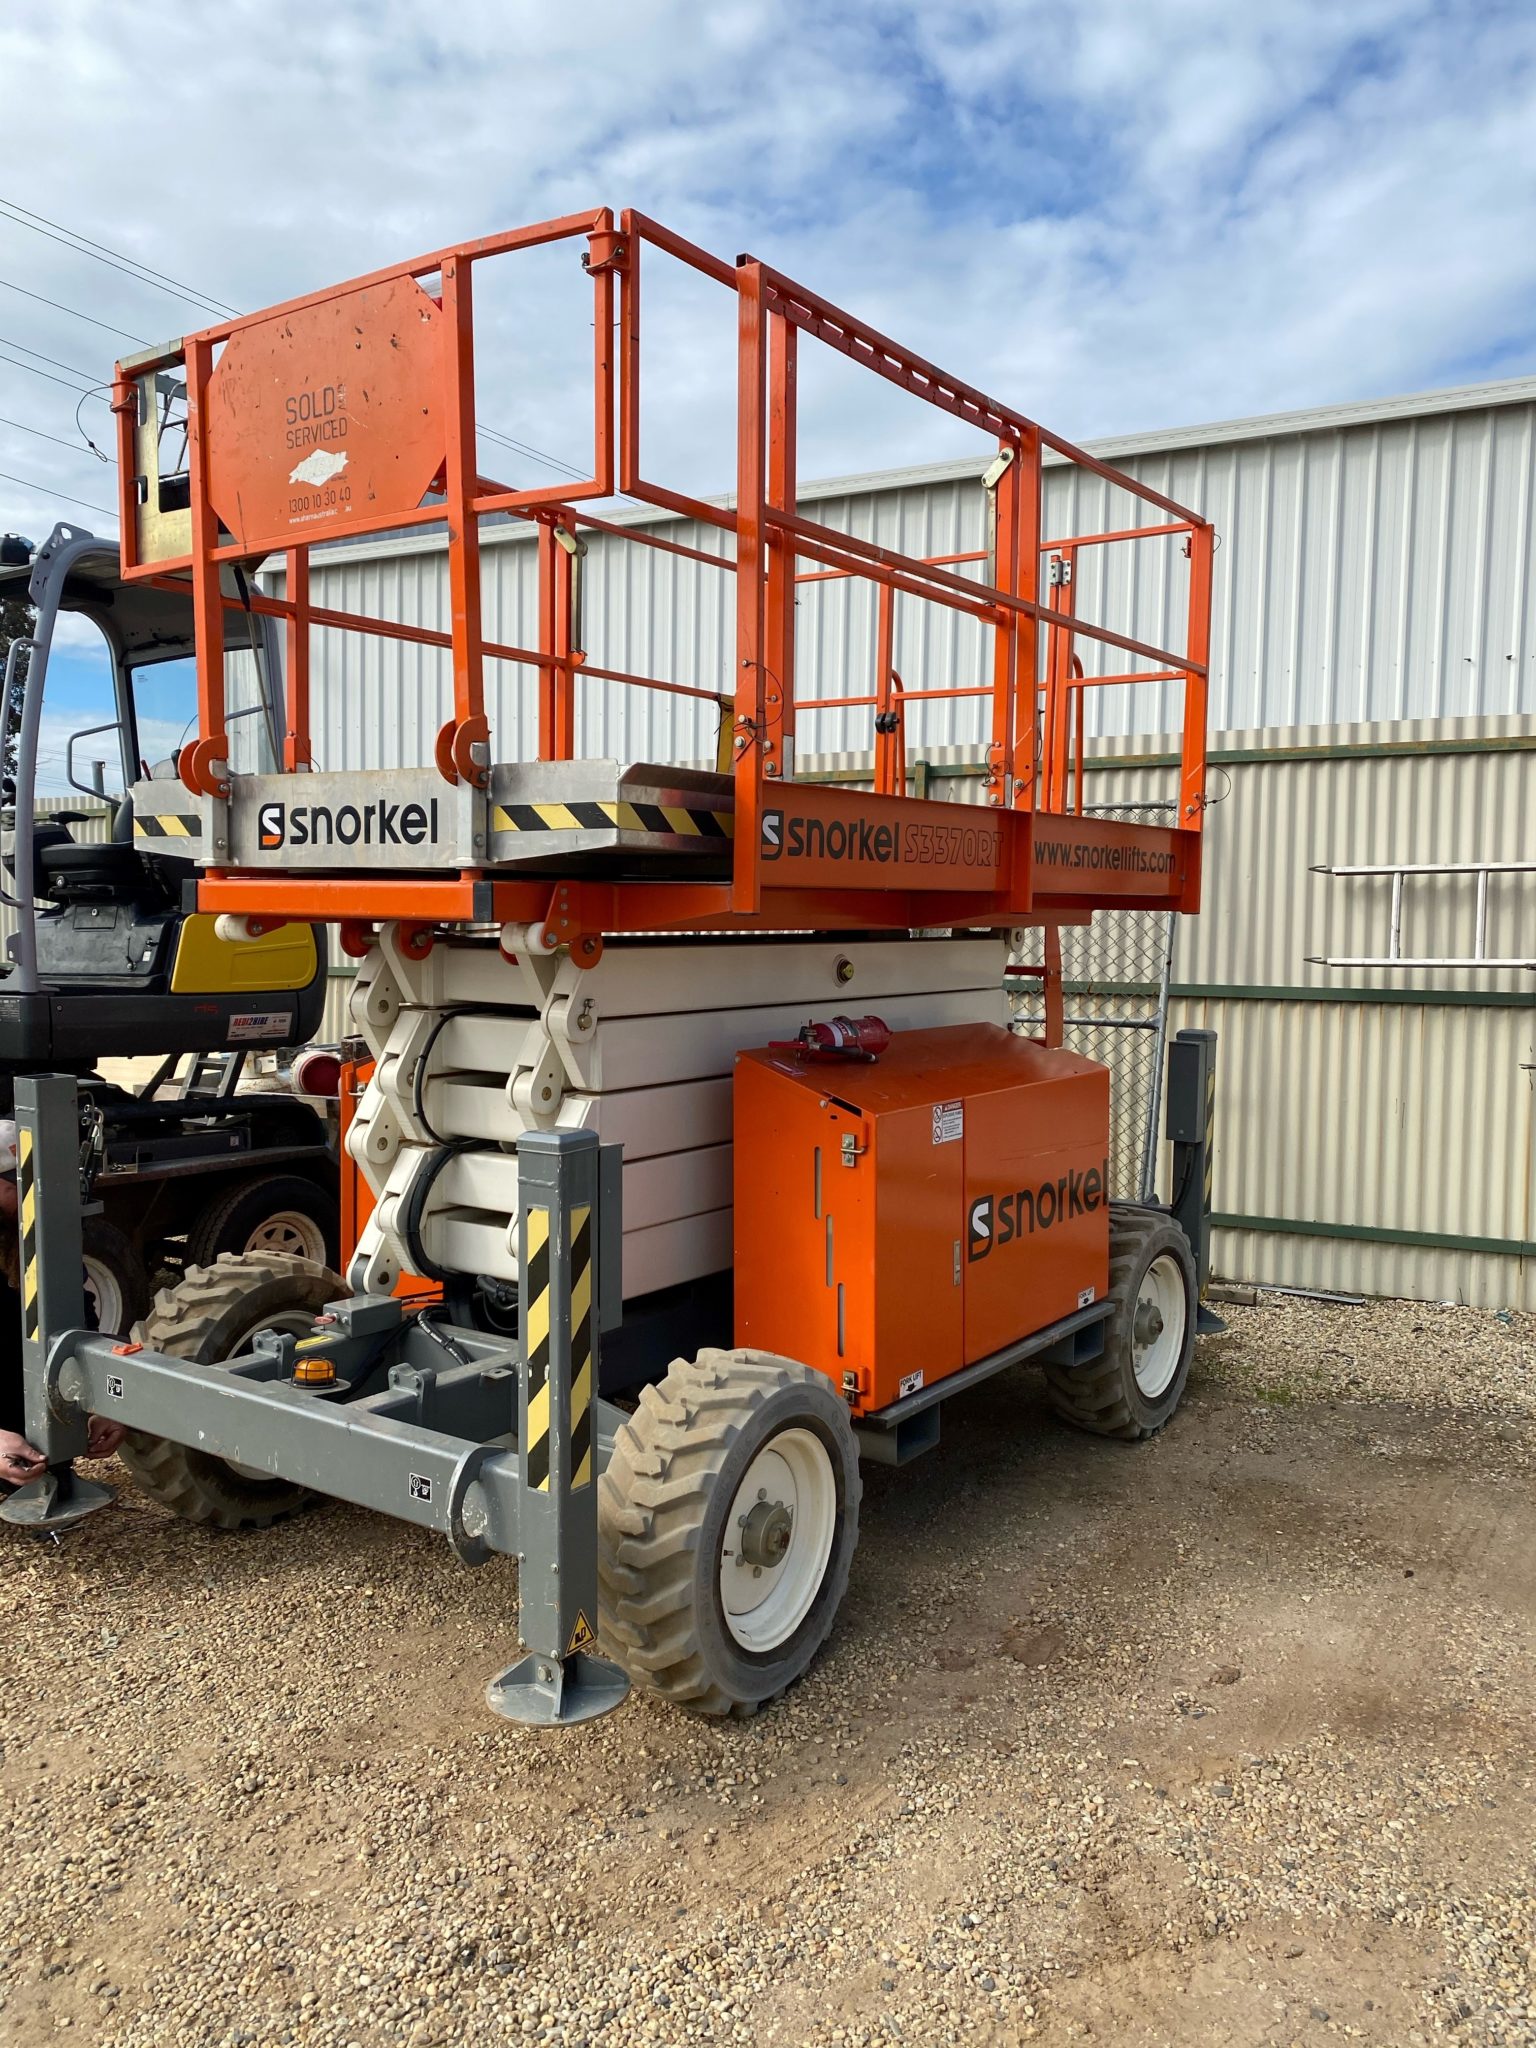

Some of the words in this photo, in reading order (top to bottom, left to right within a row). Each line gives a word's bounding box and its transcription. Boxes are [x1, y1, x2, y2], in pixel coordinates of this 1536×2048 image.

[286, 387, 335, 425] SOLD
[286, 417, 348, 449] SERVICED
[289, 497, 310, 513] 1300
[312, 494, 322, 509] 10
[324, 489, 336, 506] 30
[340, 486, 351, 502] 40
[290, 798, 438, 845] snorkel
[788, 818, 900, 863] snorkel
[904, 824, 1004, 867] S3370RT
[1034, 841, 1176, 874] www.snorkellifts.com
[998, 1158, 1108, 1246] snorkel
[900, 1376, 913, 1387] FORK
[912, 1370, 922, 1381] LIFT
